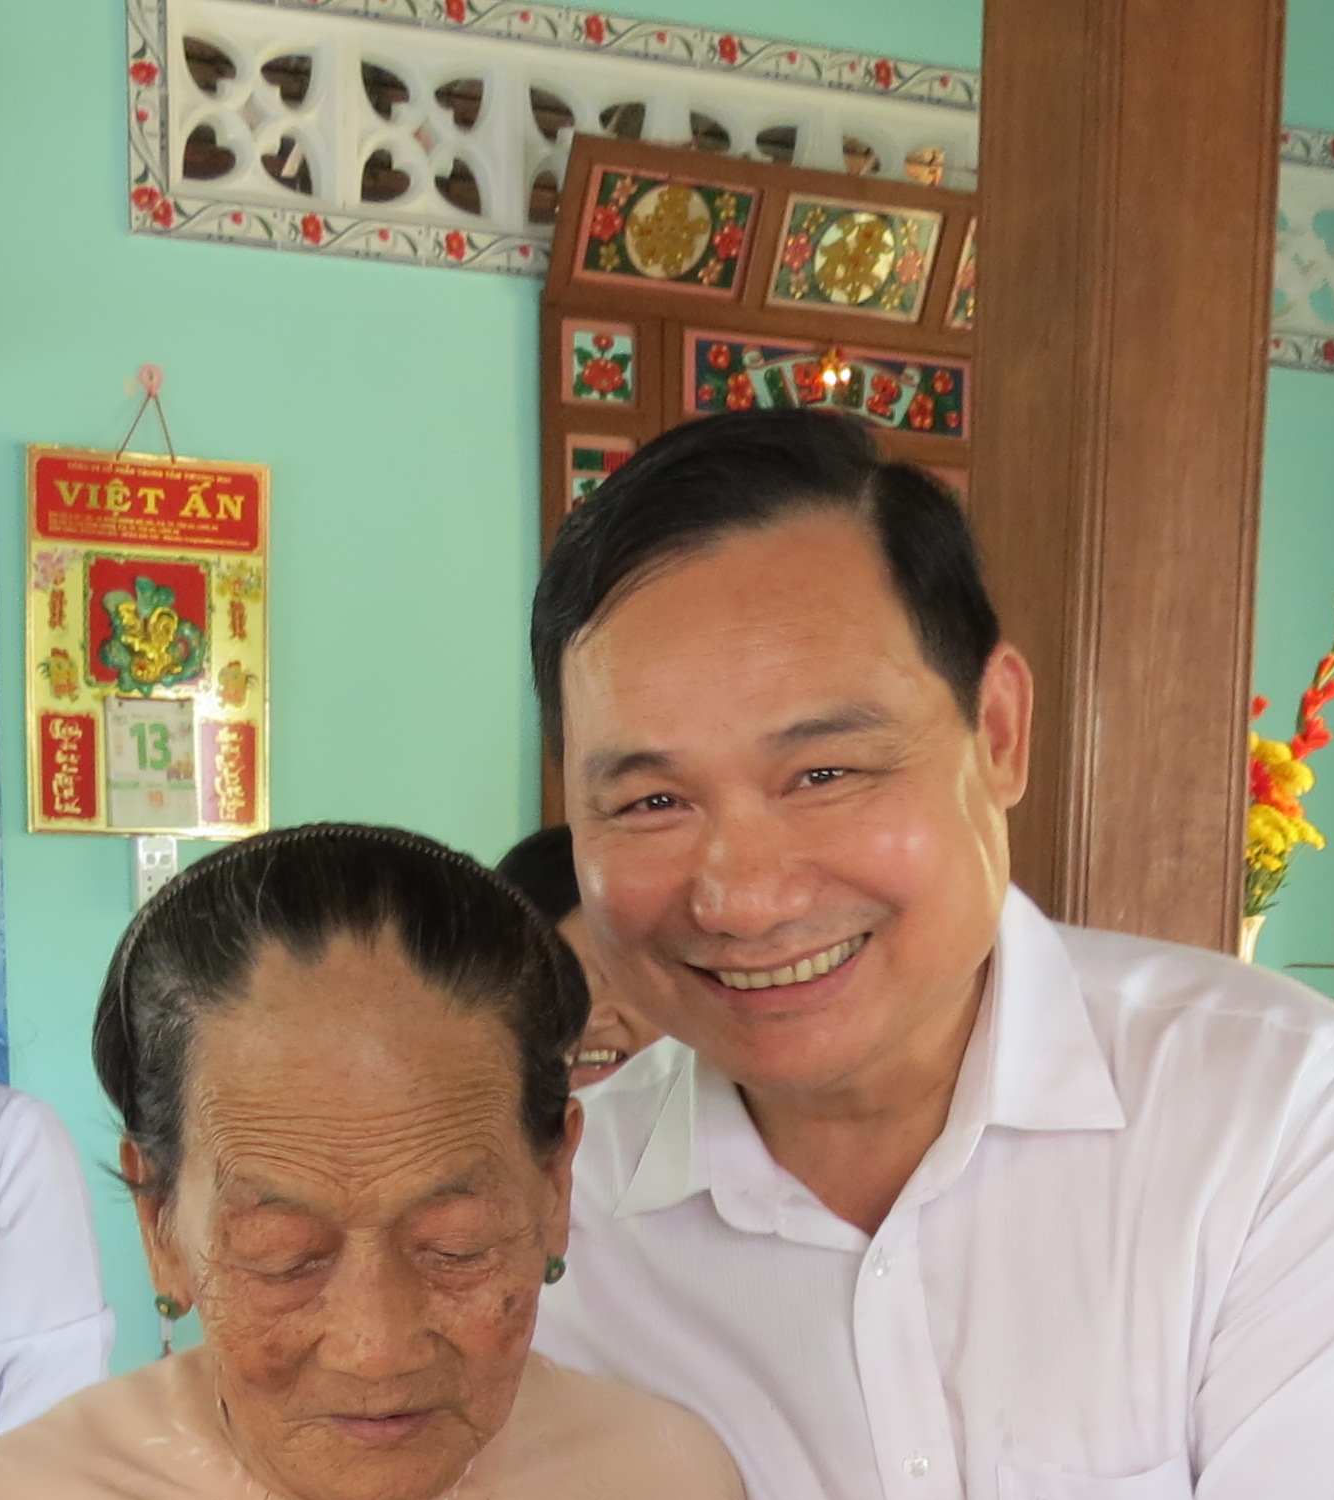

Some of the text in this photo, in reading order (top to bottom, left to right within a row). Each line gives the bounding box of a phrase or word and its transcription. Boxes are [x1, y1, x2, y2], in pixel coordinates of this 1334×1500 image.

[54, 478, 166, 519] VIỆT
[178, 480, 246, 521] ẤN
[129, 722, 173, 771] 13
